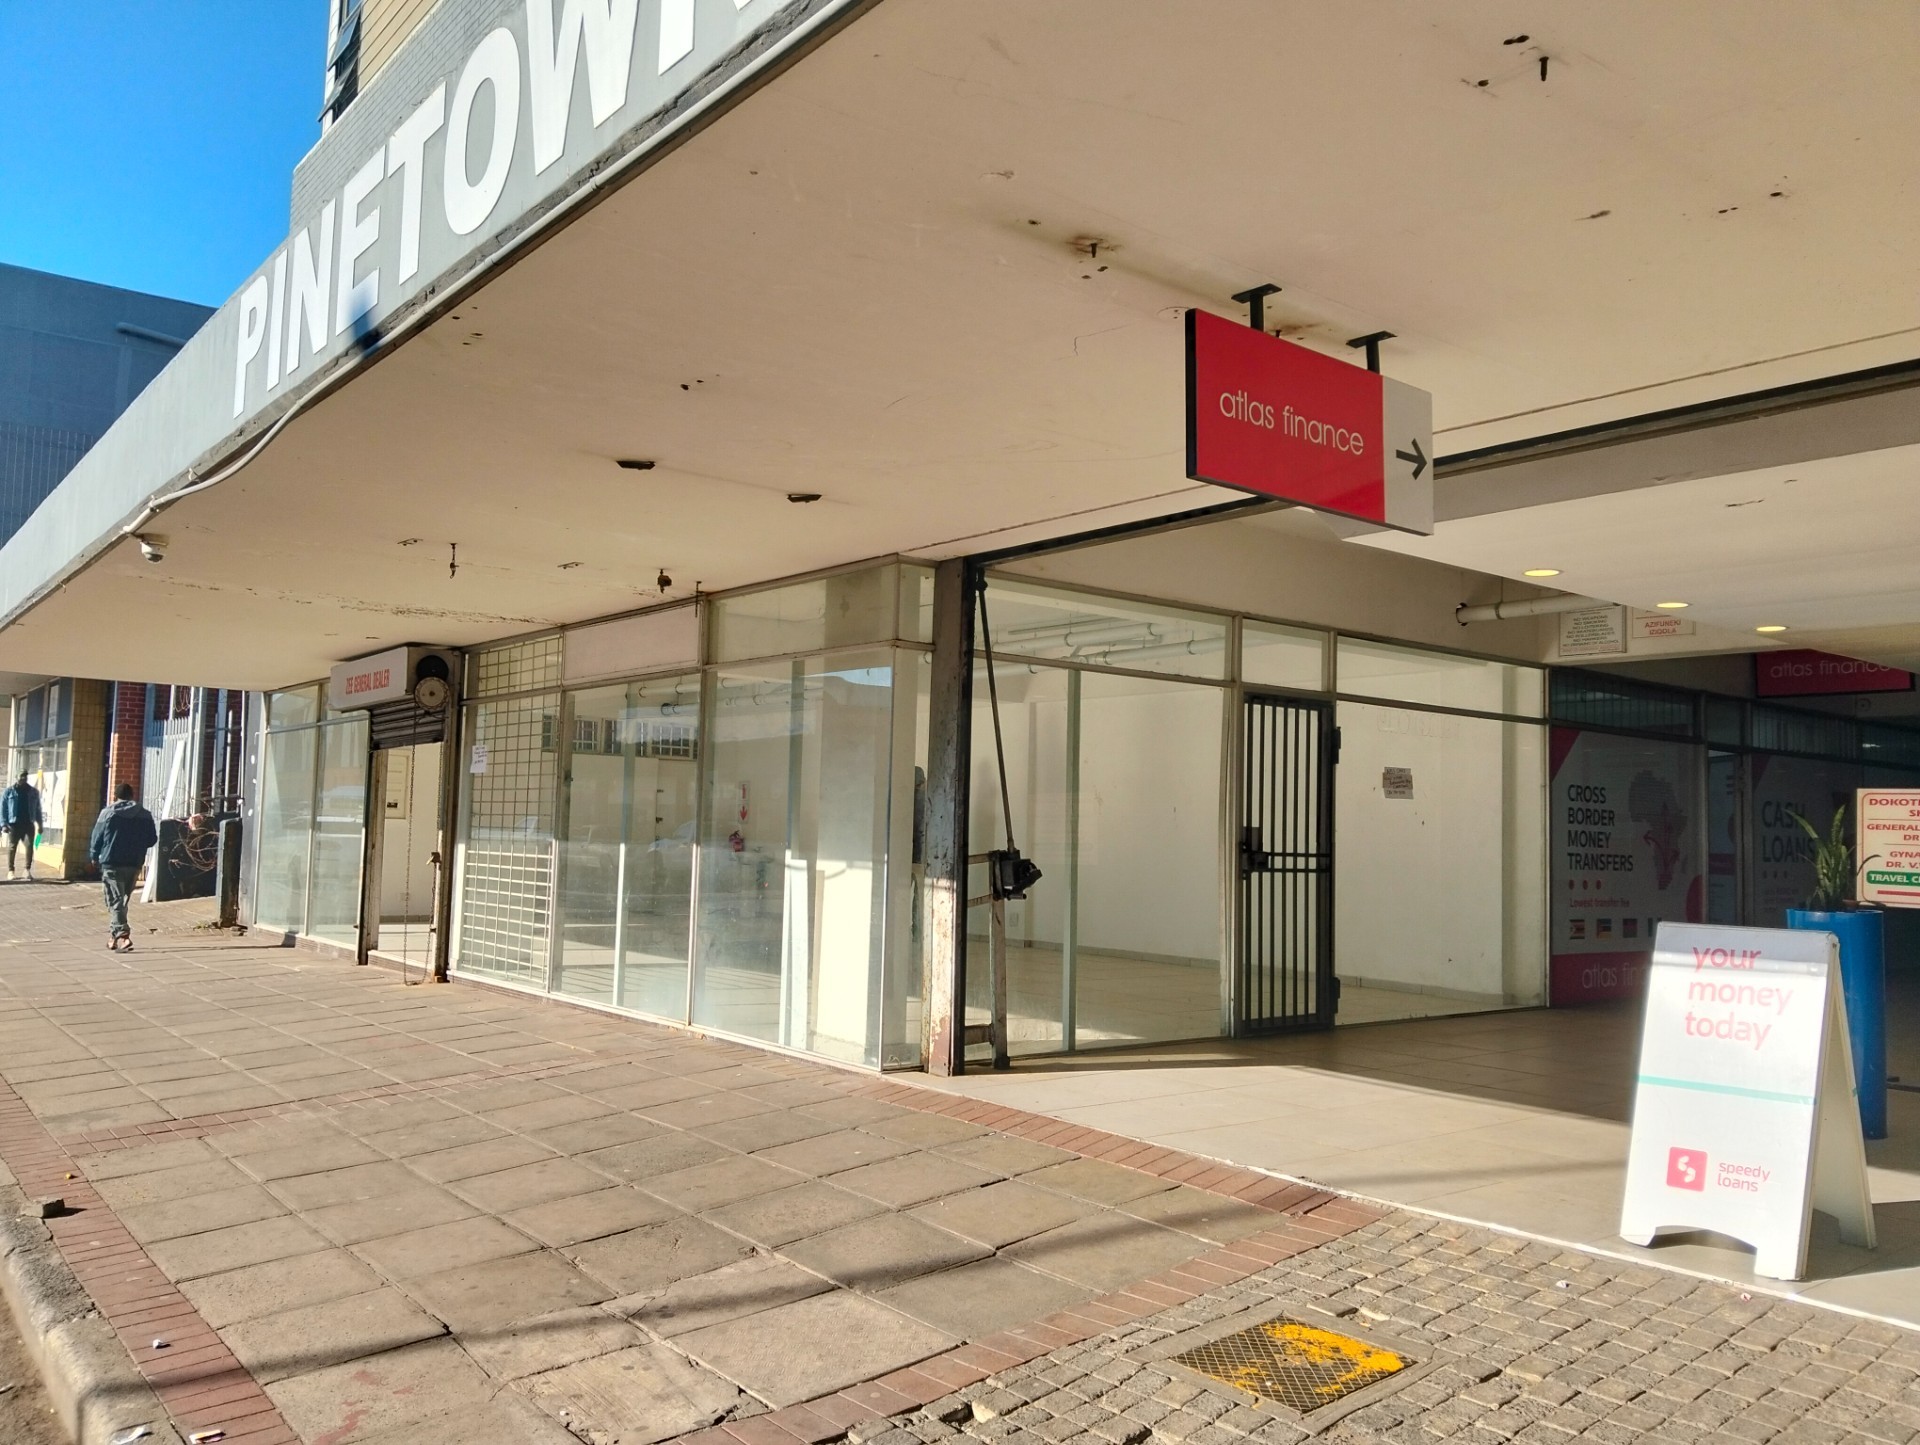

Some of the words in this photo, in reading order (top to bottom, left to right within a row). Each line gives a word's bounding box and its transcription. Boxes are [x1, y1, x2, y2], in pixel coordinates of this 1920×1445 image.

[1219, 389, 1275, 429] atlas
[1282, 405, 1364, 455] finance
[1770, 662, 1813, 678] atlas
[1568, 784, 1607, 804] CROSS
[1568, 807, 1616, 827] BORDER
[1568, 830, 1611, 849] MONEY
[1567, 853, 1634, 872] TRANSFERS
[1870, 873, 1909, 882] TRAVEL
[1912, 875, 1920, 884] C
[1693, 947, 1762, 973] your
[1582, 962, 1618, 989] atlas
[1688, 982, 1794, 1016] money
[1685, 1012, 1772, 1051] today
[1717, 1173, 1759, 1192] loans
[1719, 1162, 1771, 1183] speedy
